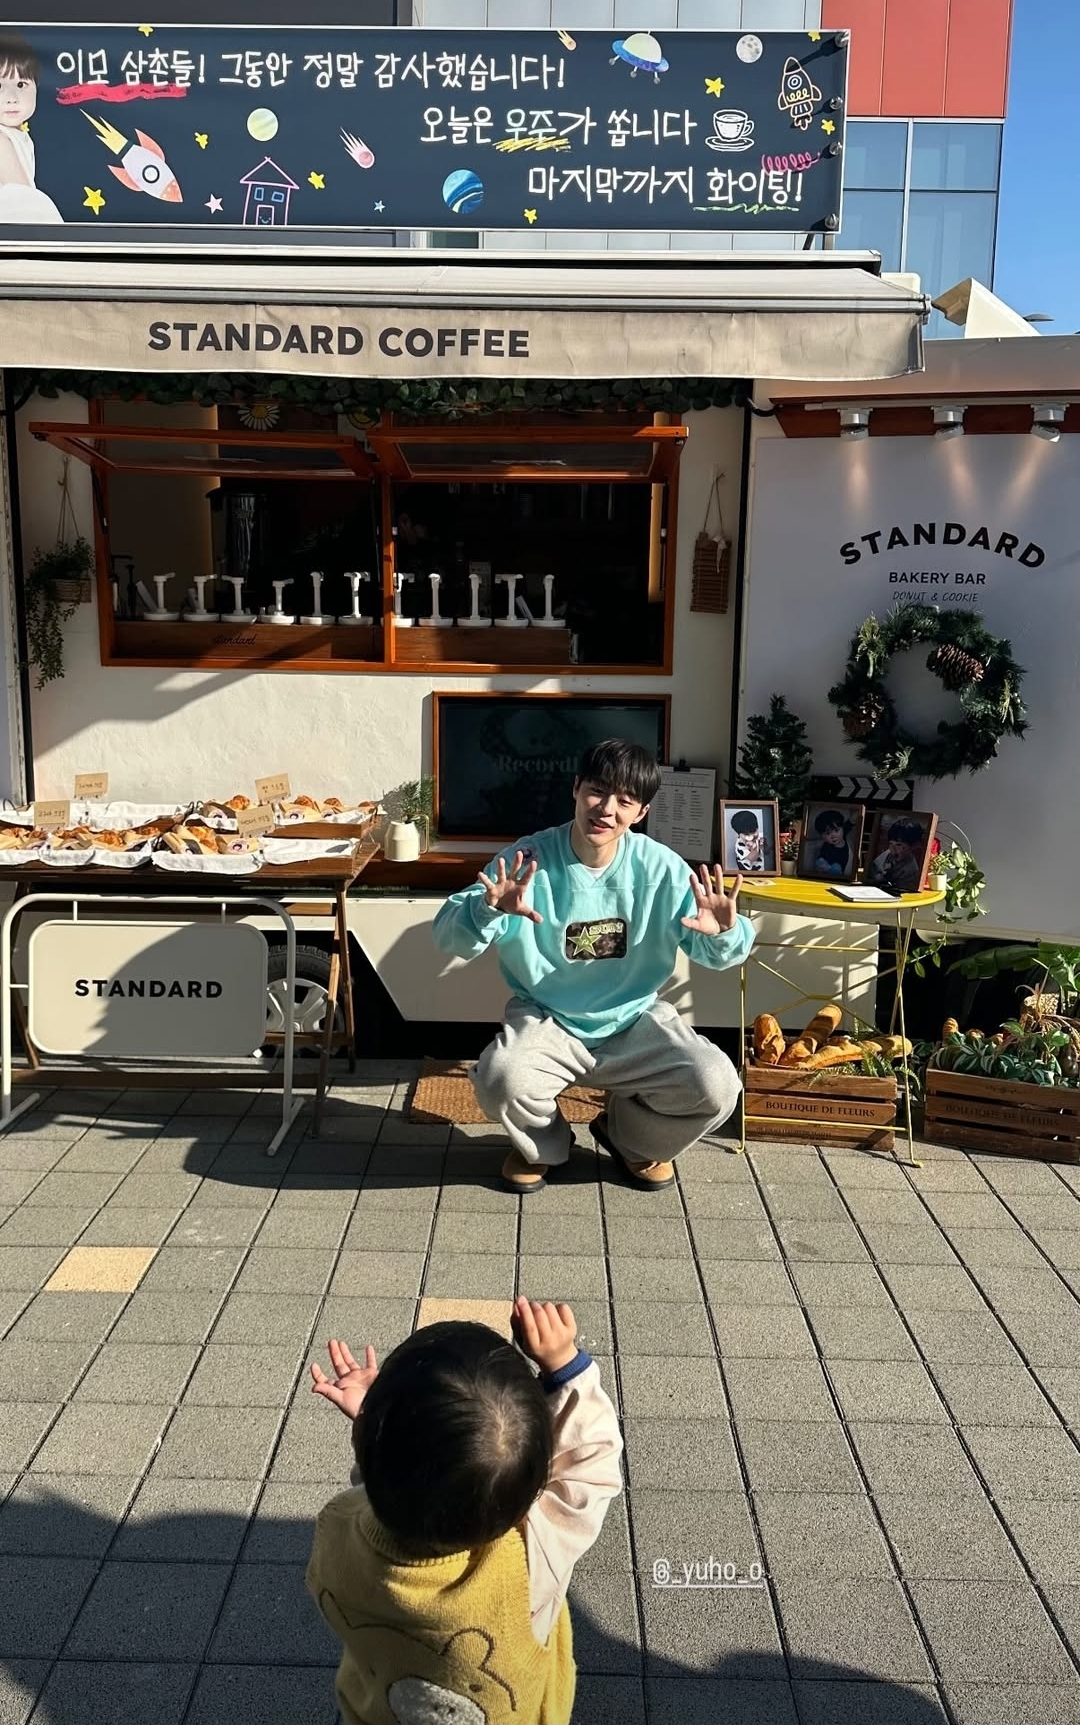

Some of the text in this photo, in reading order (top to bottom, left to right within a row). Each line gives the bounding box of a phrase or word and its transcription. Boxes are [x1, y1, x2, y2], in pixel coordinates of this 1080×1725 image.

[57, 47, 566, 91] 이모 삼촌들! 그동안 정말 감사했습니다!
[420, 106, 698, 146] 오늘은 우주가 쏩니다
[528, 165, 803, 205] 마지막까지 화이팅!
[148, 321, 530, 358] STANDARD COFFEE
[839, 522, 1045, 568] STANDARD
[888, 571, 986, 585] BAKERY BAR
[892, 591, 979, 602] DONUT & COOKIE
[75, 979, 223, 999] STANDARD
[765, 1101, 875, 1117] BOUTIQUE DE FLEURS
